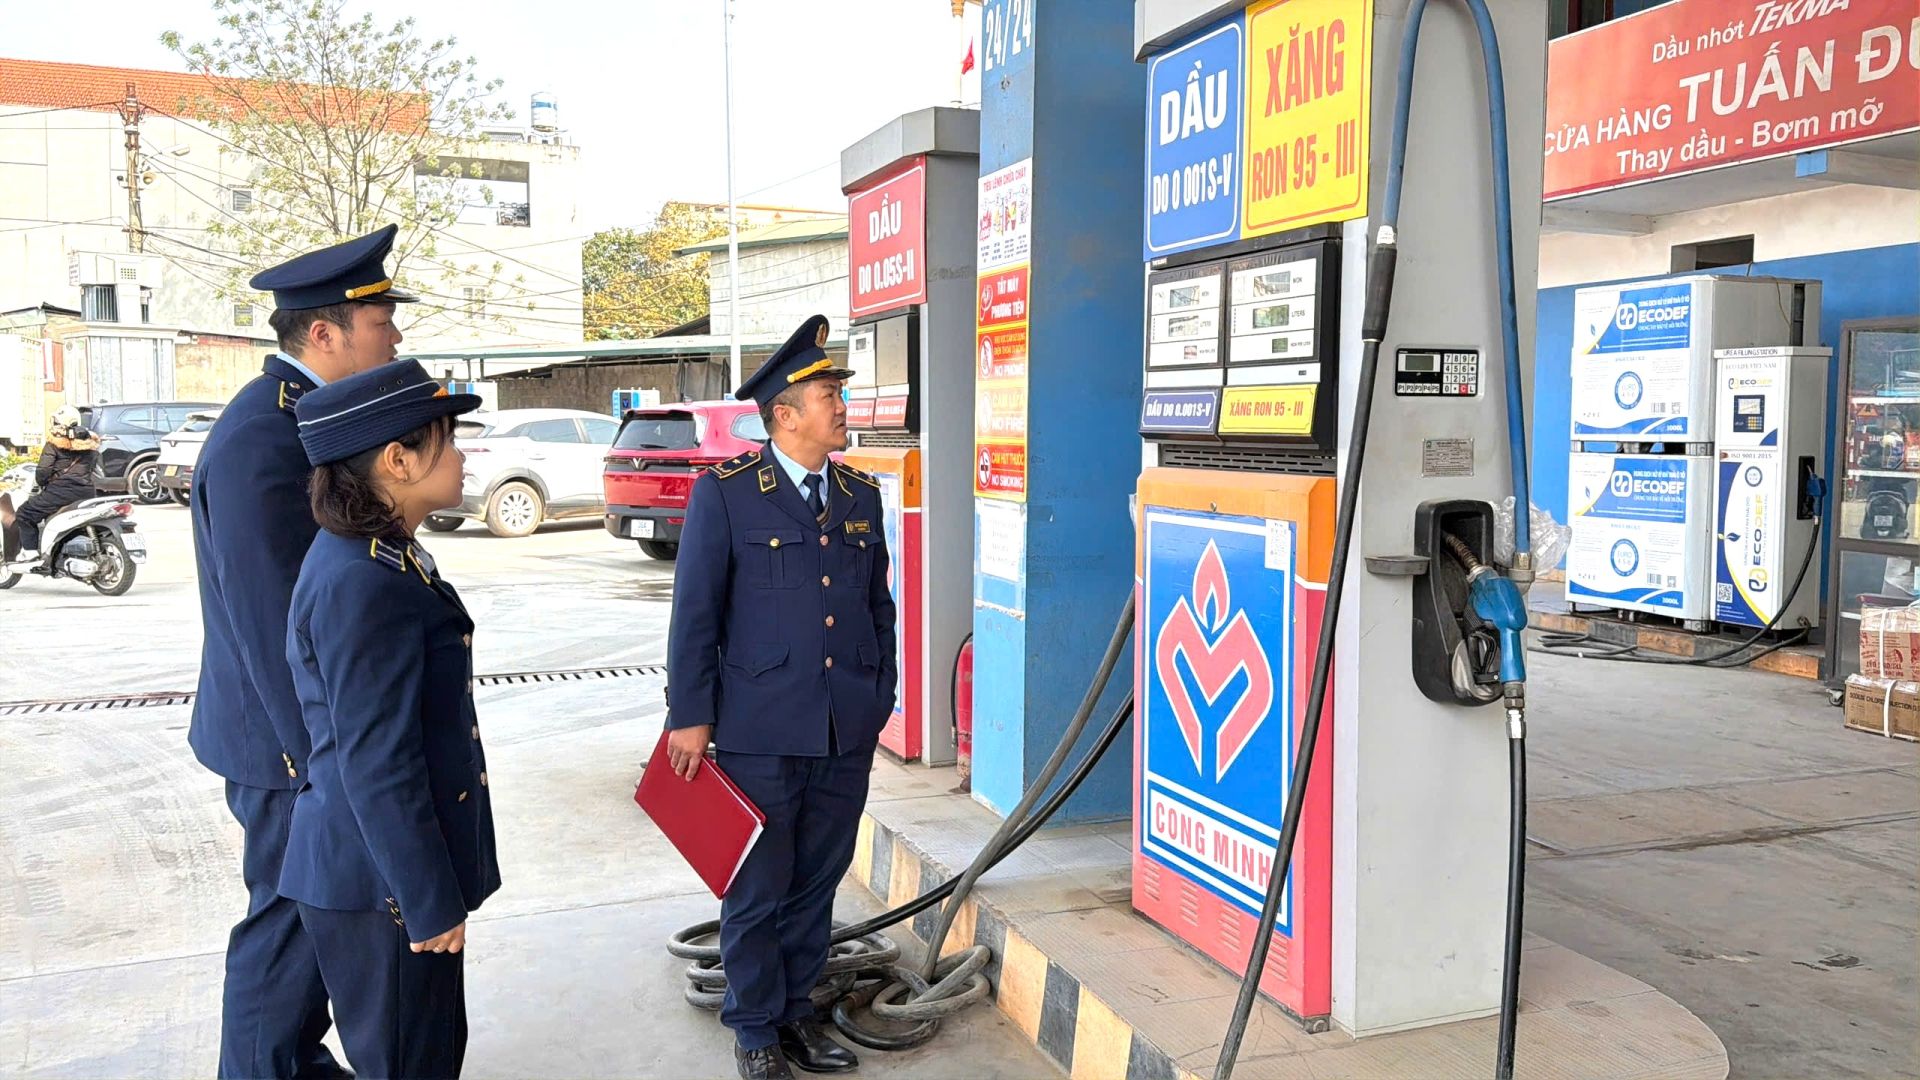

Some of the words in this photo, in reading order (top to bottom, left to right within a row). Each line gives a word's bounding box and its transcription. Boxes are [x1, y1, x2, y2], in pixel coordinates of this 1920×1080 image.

[1652, 34, 1689, 64] Dầu
[1697, 20, 1745, 51] nhớt
[1264, 19, 1345, 118] XĂNG
[1160, 59, 1228, 146] DẦU
[1544, 124, 1590, 156] CỬA
[1596, 104, 1672, 144] HÀNG
[1679, 39, 1835, 123] TUẤN
[1252, 142, 1288, 202] RON
[1293, 133, 1317, 190] 95
[1336, 119, 1355, 179] III
[1616, 146, 1674, 174] Thay
[1680, 128, 1726, 158] dầu
[1752, 115, 1819, 148] Bơm
[1830, 97, 1884, 132] mỡ
[869, 192, 901, 244] DẦU
[1153, 173, 1169, 215] DO
[858, 263, 872, 295] DO
[874, 248, 915, 291] 0.05S-II
[1639, 306, 1689, 323] ECODEF
[1163, 403, 1174, 416] DO
[1175, 402, 1211, 416] 0.001S-V
[1230, 400, 1252, 416] XĂNG
[1254, 402, 1271, 416] RON
[1274, 402, 1284, 416] 95
[1294, 401, 1303, 416] III
[1634, 480, 1685, 494] ECODEF
[1753, 493, 1763, 565] ECODEF
[1155, 801, 1205, 856] CONG
[1213, 830, 1271, 889] MINH
